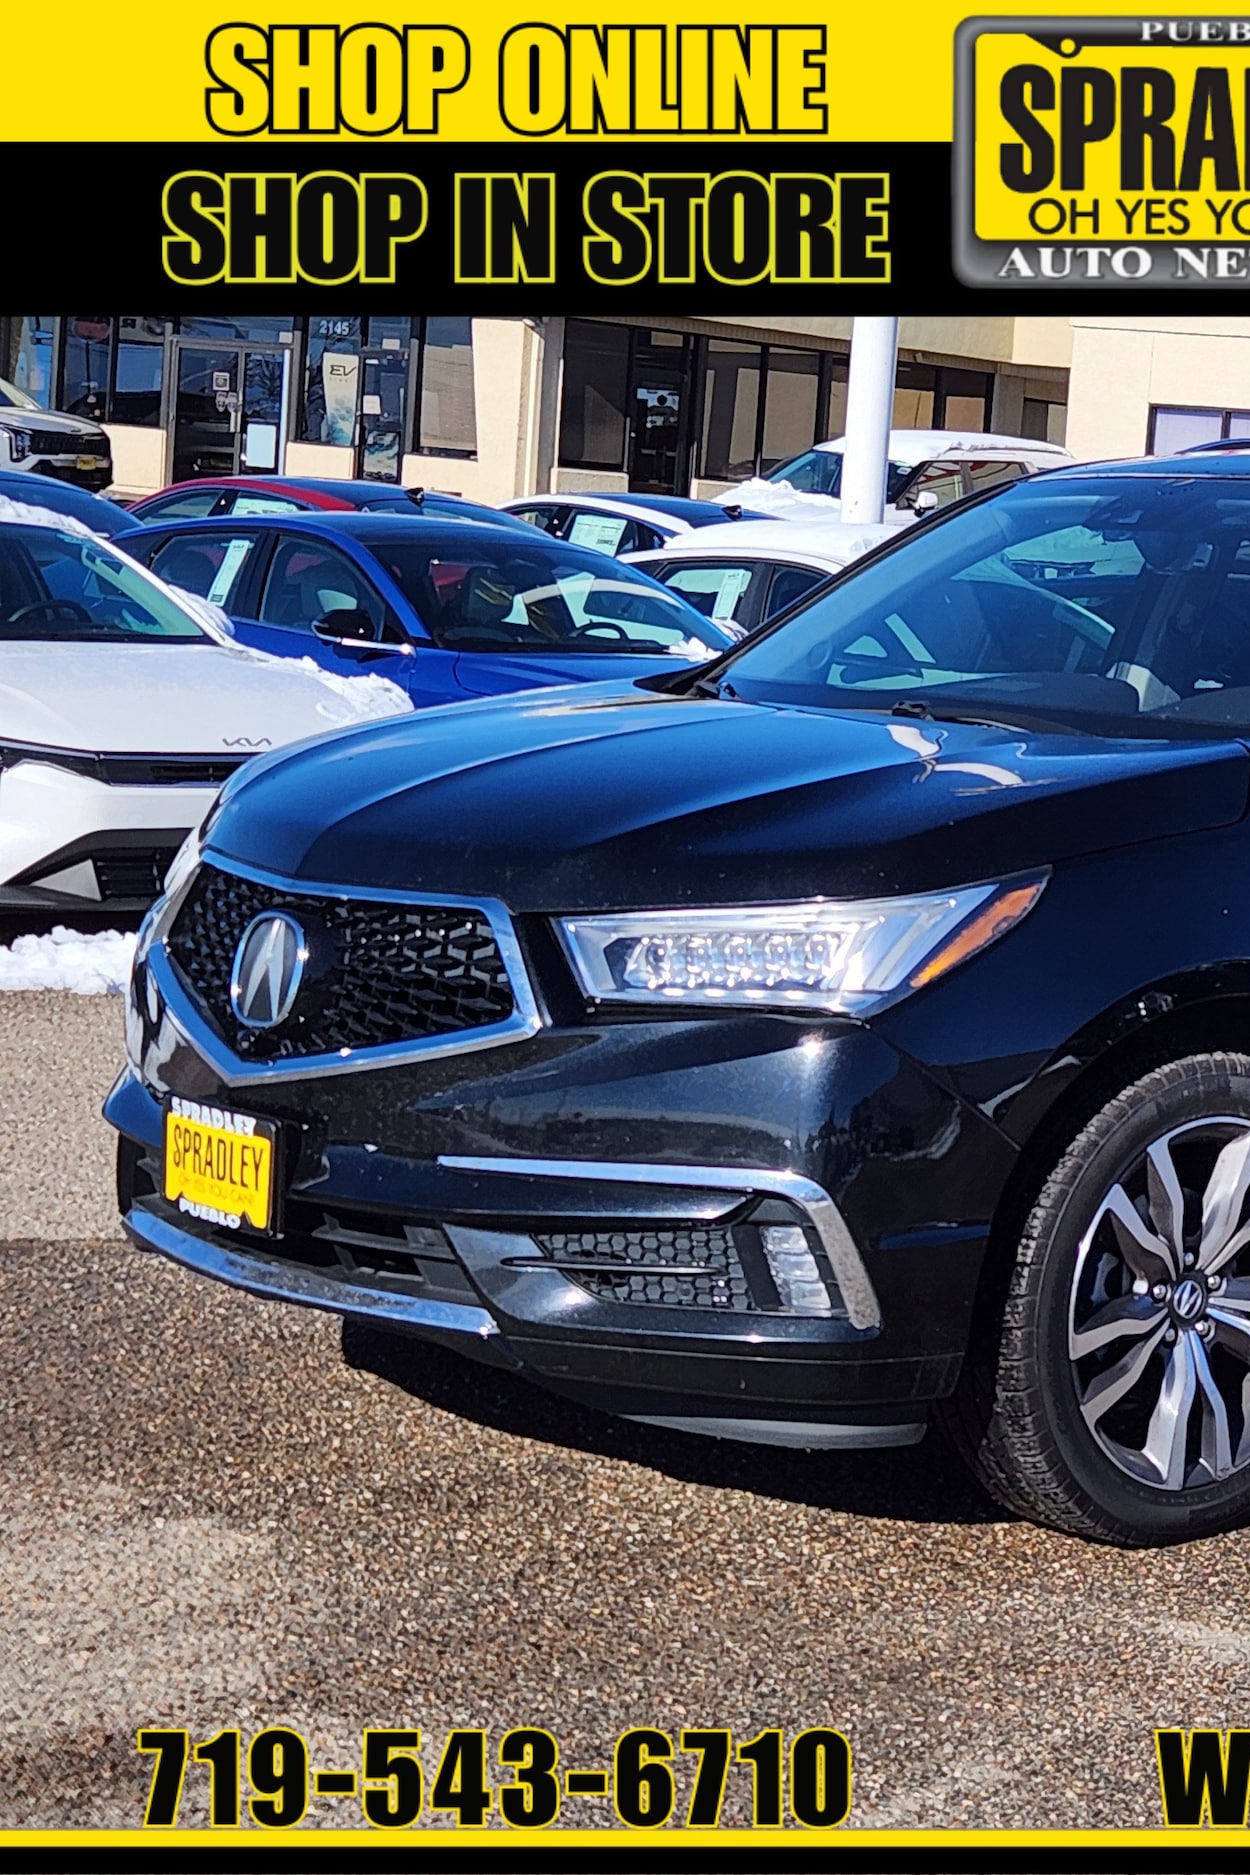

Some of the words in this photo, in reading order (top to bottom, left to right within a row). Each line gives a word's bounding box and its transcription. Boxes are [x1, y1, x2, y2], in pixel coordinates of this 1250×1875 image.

[319, 320, 350, 335] 2145
[329, 365, 357, 377] EV
[171, 1096, 257, 1137] SPRADLEY
[173, 1124, 264, 1192] SPRADLEY
[178, 1197, 241, 1229] PUEBLO
